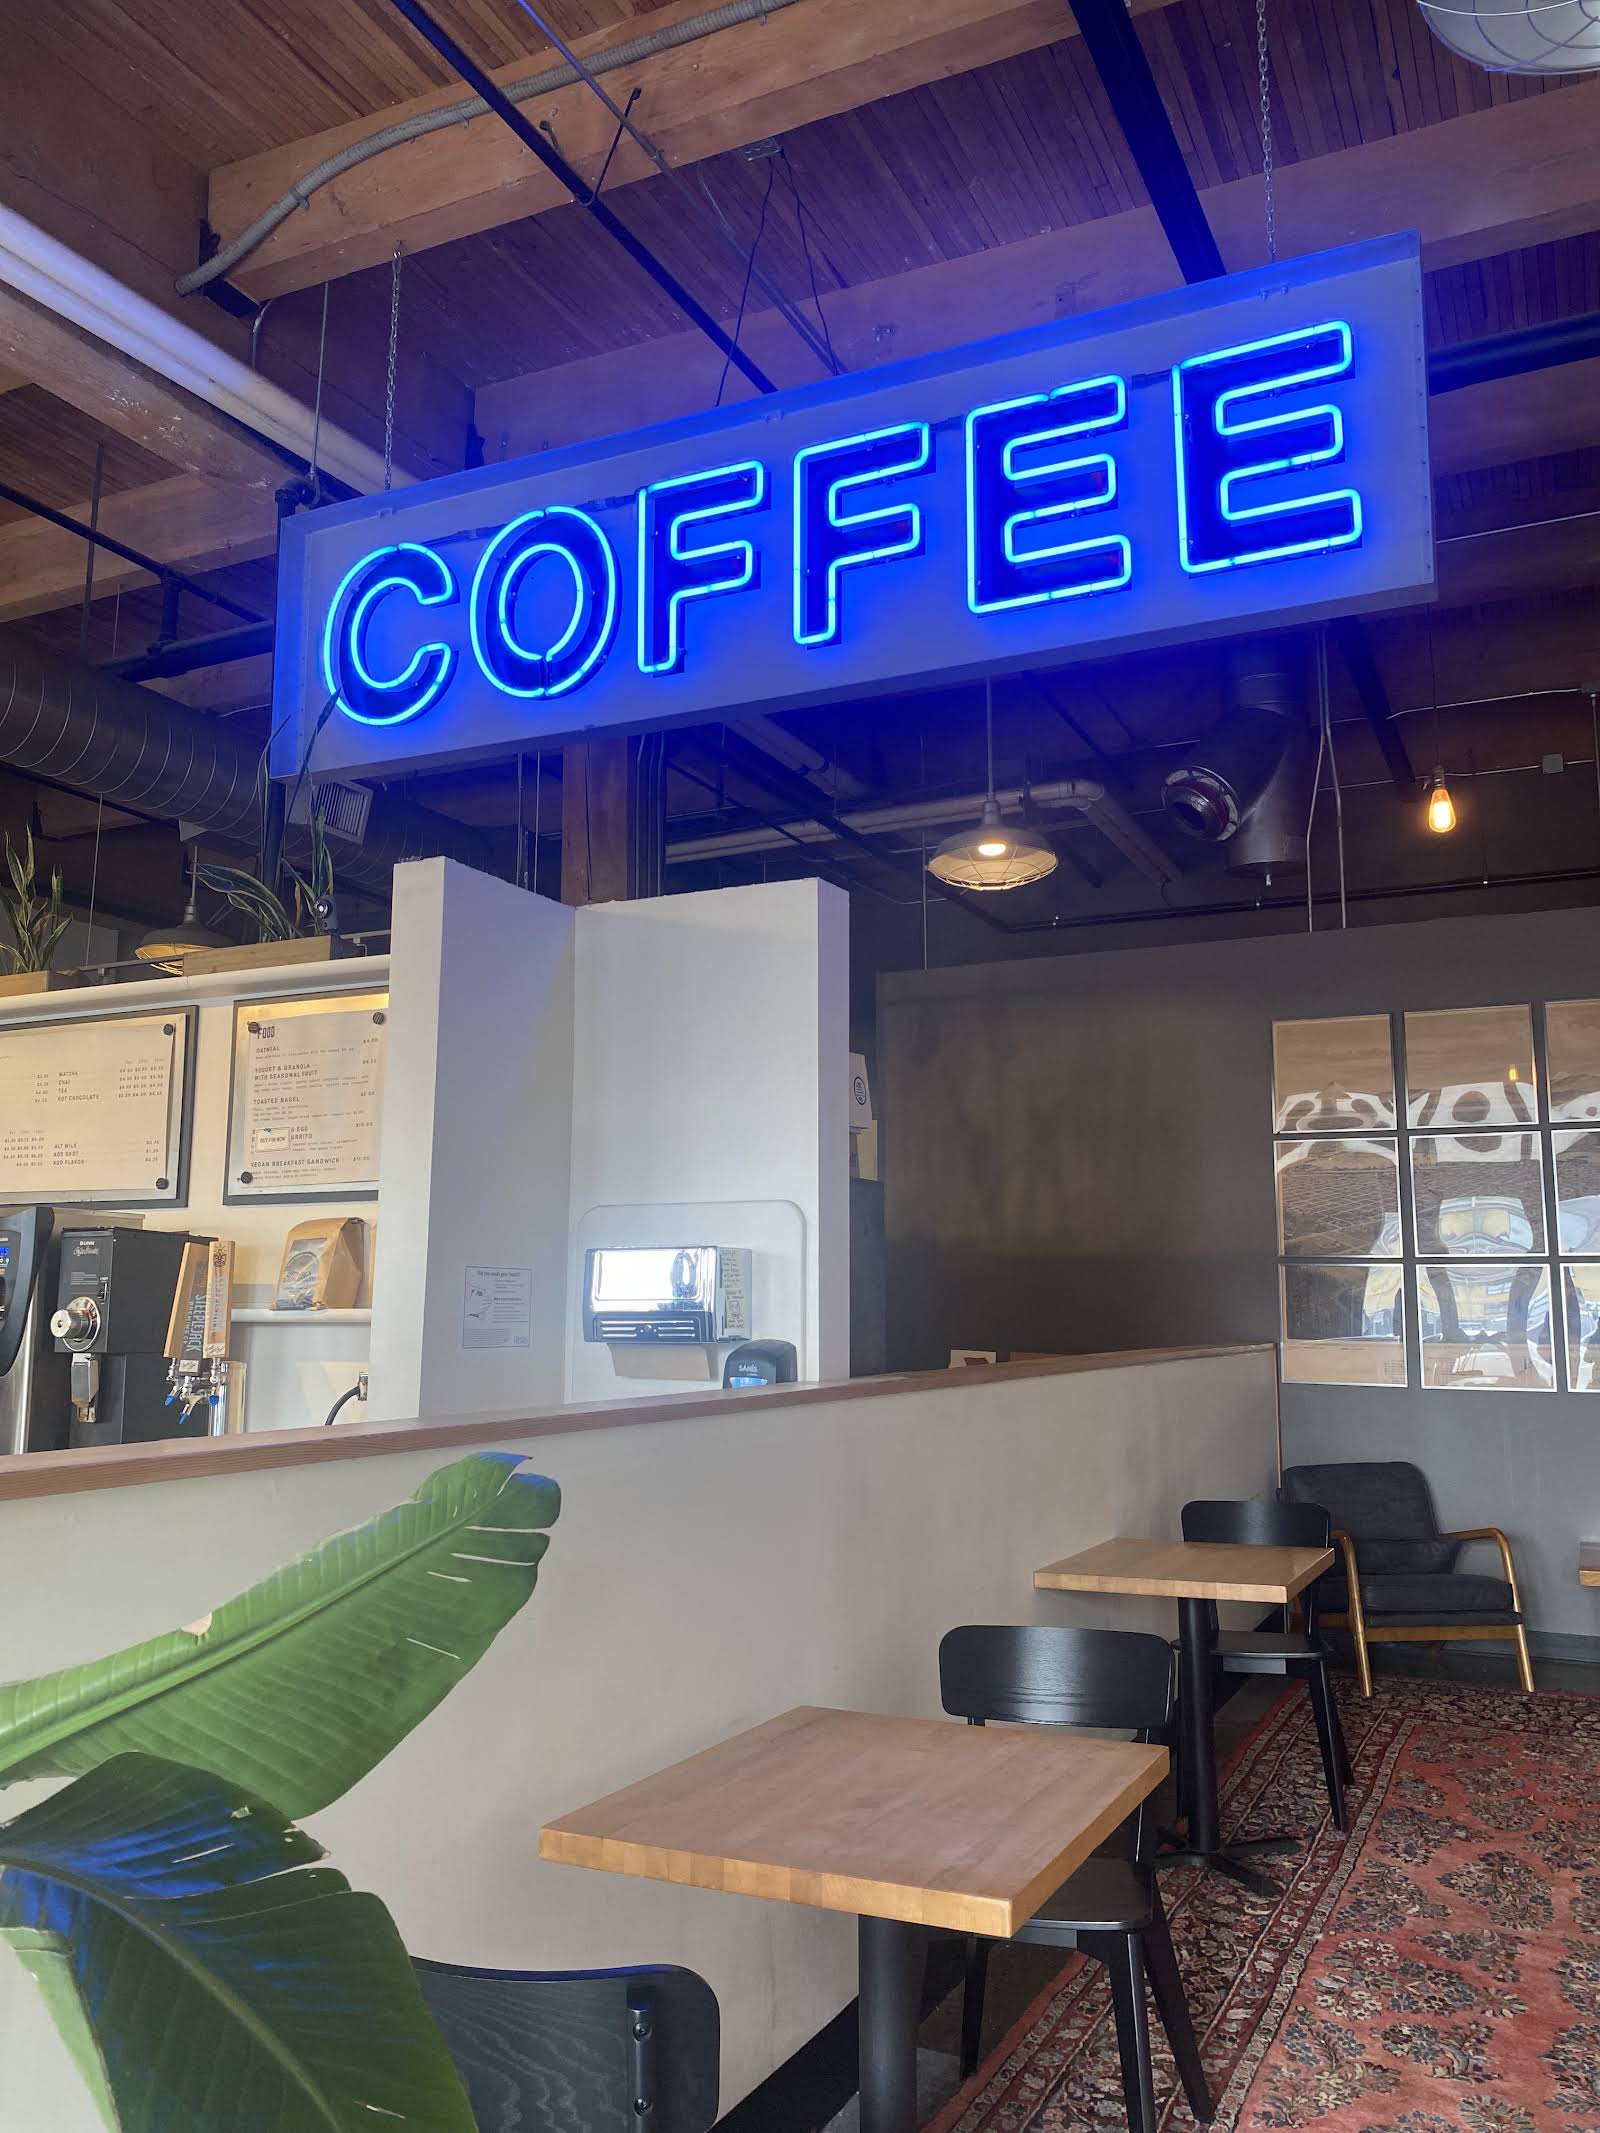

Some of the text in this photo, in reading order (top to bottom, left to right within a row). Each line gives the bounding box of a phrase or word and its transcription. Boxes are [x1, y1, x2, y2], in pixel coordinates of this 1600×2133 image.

[322, 320, 1364, 728] COFFEE
[257, 1026, 275, 1040] FOOD
[256, 1046, 280, 1054] OATMEAL
[283, 1063, 310, 1071] GRANOLA
[269, 1071, 301, 1079] SEASONAL
[253, 1097, 279, 1105] TOASTED
[251, 1157, 340, 1168] VEGAN BREAKFAST SANDWICH
[186, 1294, 207, 1352] STEEPLEJACK
